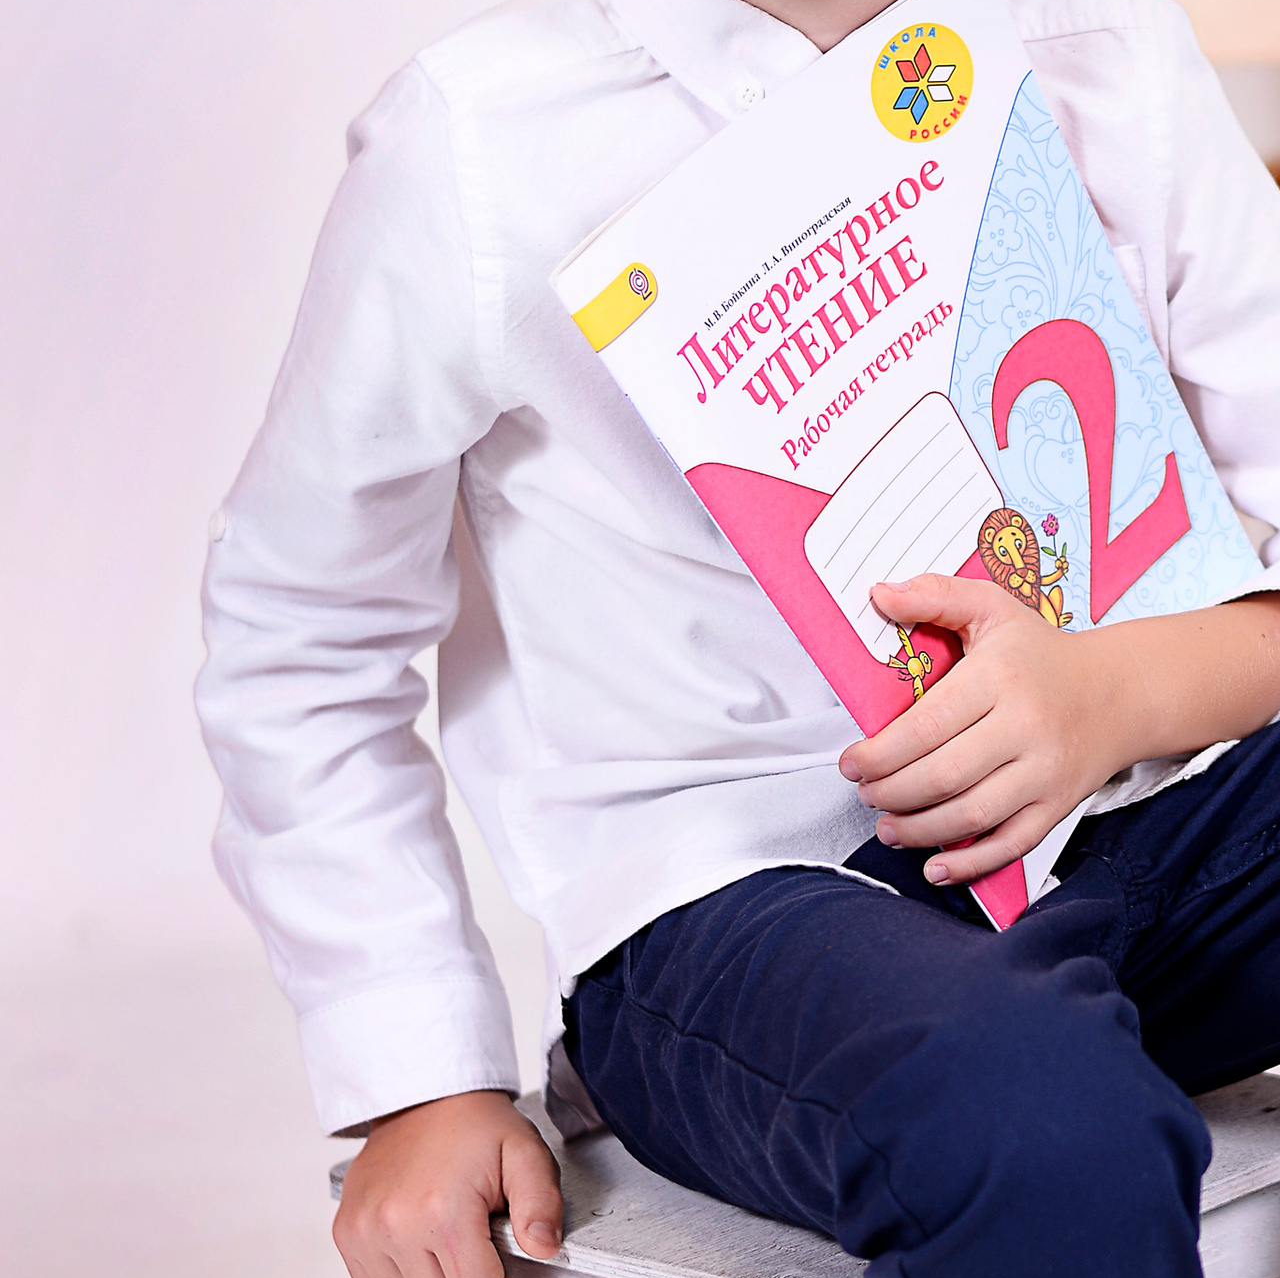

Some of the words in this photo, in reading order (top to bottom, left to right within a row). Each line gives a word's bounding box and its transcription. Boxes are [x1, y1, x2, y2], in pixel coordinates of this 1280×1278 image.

[878, 27, 936, 70] ШКОЛА
[909, 95, 967, 139] РОССИИ
[676, 159, 944, 404] Литературное
[720, 273, 761, 313] Бойкина
[780, 197, 852, 257] Виноградская
[741, 234, 928, 414] ЧТЕНИЕ
[780, 377, 866, 471] Рабочая
[862, 300, 953, 385] тетрадь
[991, 319, 1193, 625] 2
